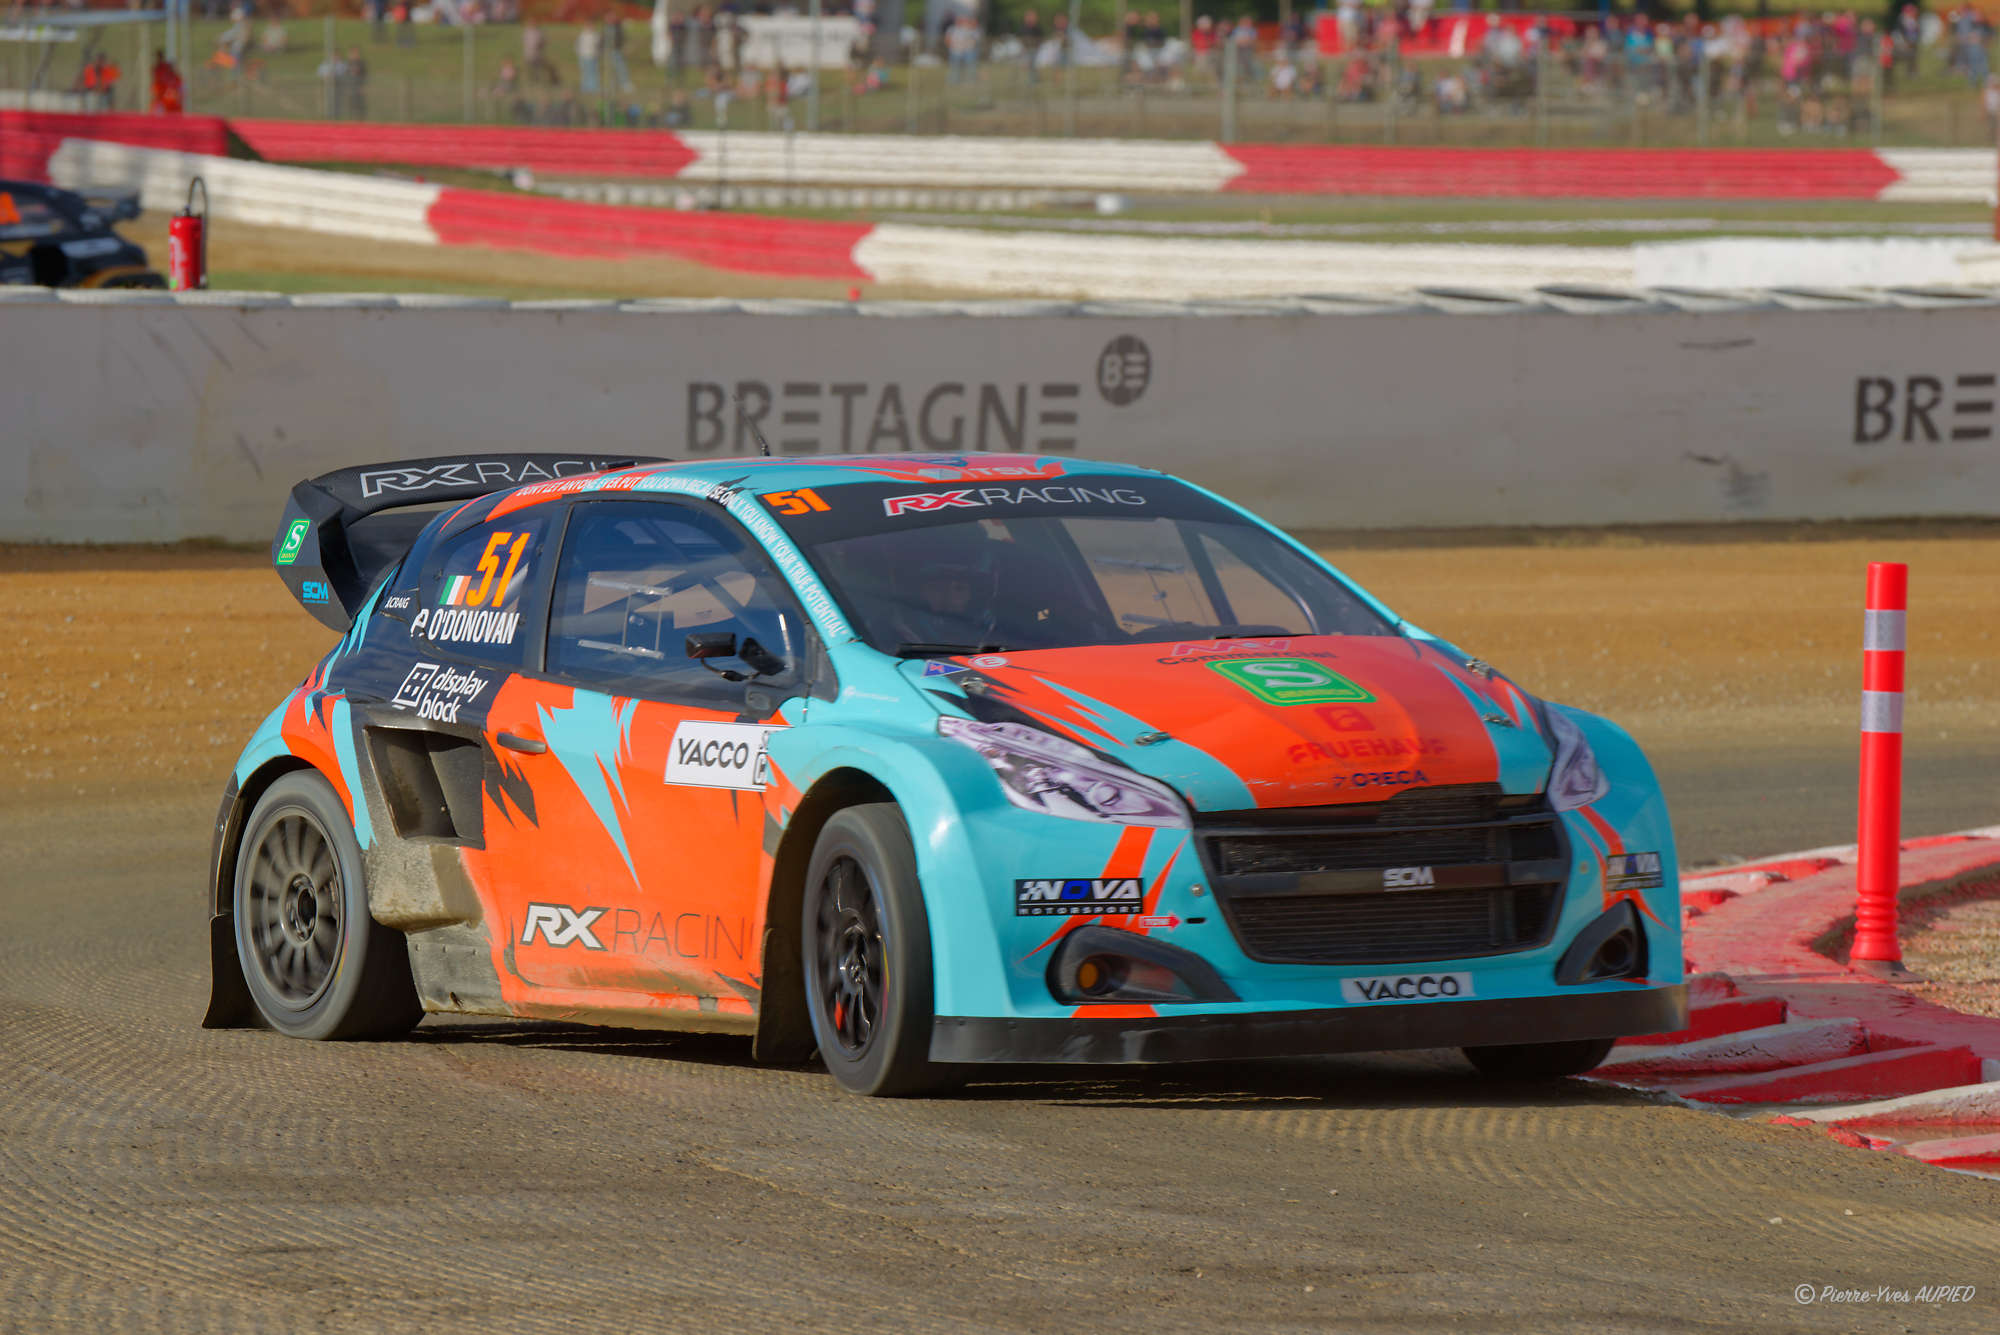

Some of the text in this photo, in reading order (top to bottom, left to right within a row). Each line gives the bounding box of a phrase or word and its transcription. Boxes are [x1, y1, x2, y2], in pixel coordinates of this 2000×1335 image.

[685, 380, 1081, 453] BRETAGNE
[1855, 374, 1996, 443] BRE
[762, 487, 832, 515] 51
[465, 532, 531, 608] 51
[428, 608, 520, 644] O'DONOVAN
[432, 666, 488, 703] display
[417, 691, 462, 724] block
[678, 738, 749, 769] YACCO
[1354, 975, 1459, 1001] YACCO
